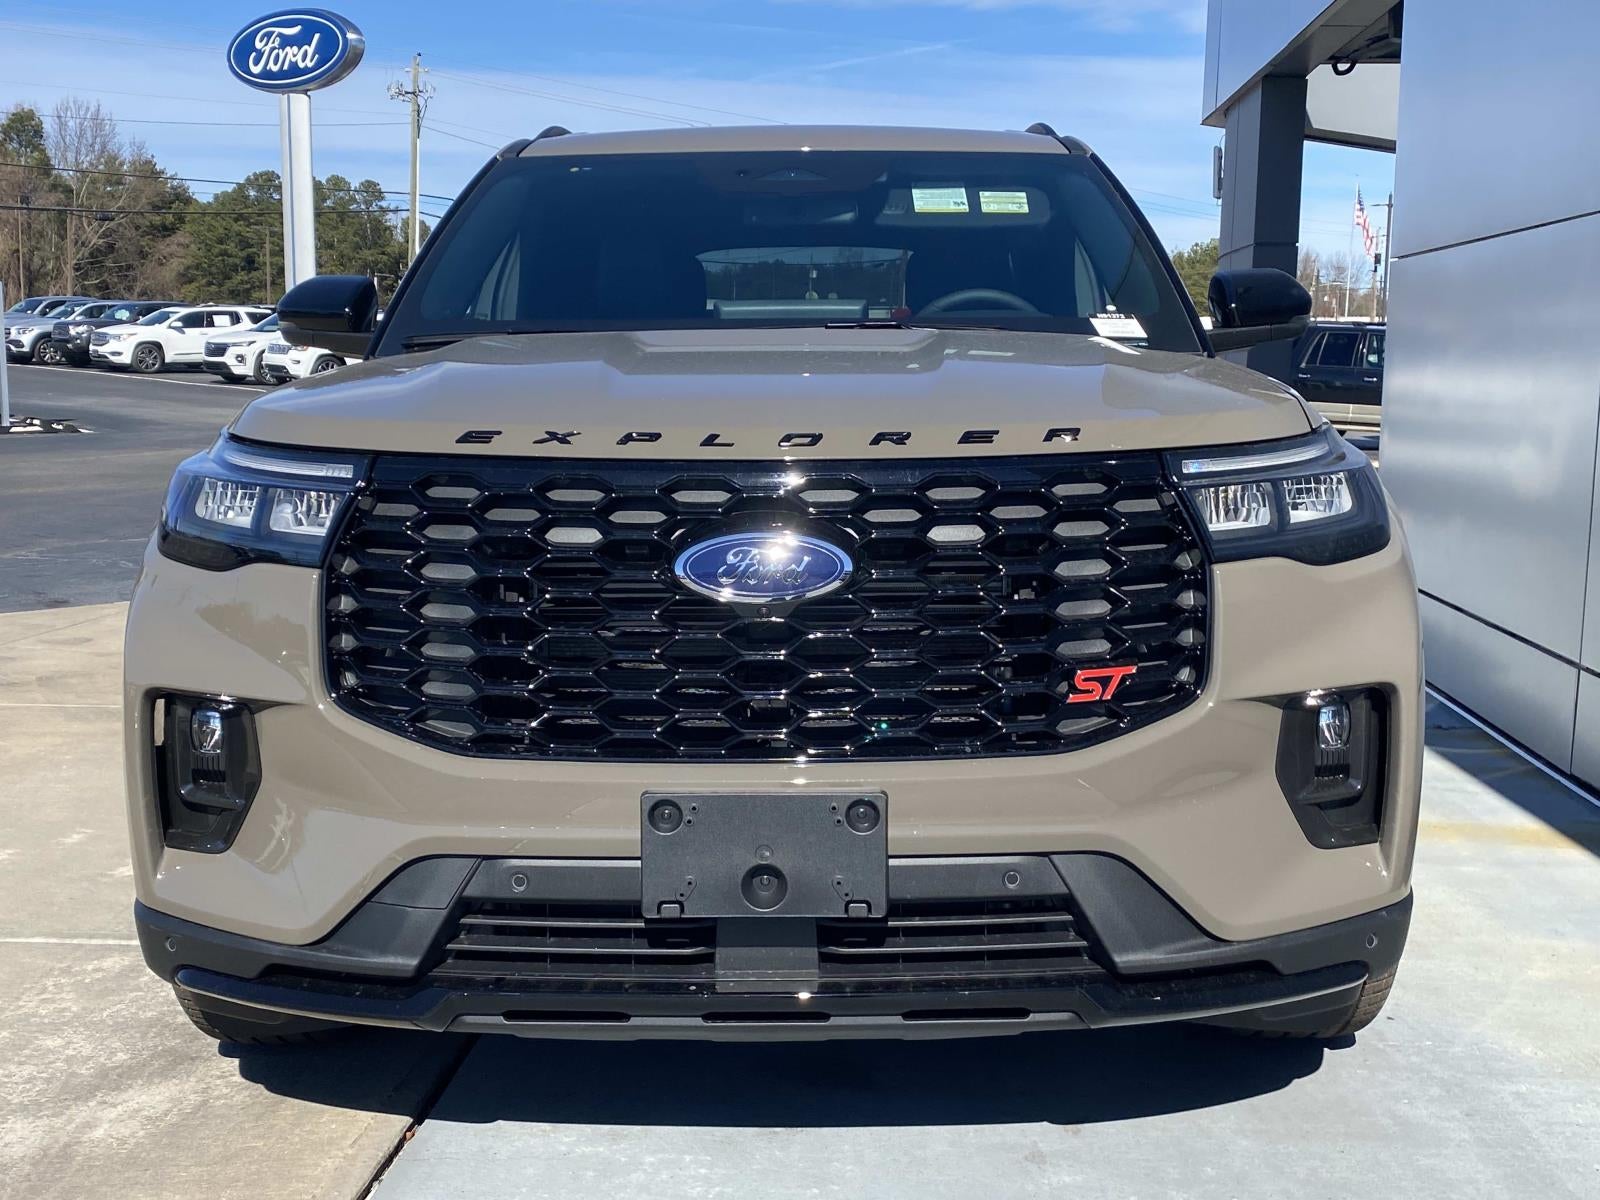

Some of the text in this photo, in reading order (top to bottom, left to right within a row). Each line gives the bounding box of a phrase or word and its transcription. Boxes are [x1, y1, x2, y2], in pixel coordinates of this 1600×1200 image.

[248, 25, 321, 74] Ford
[455, 427, 1081, 447] EXPLORER
[716, 546, 812, 585] Ford
[1066, 665, 1137, 704] ST
